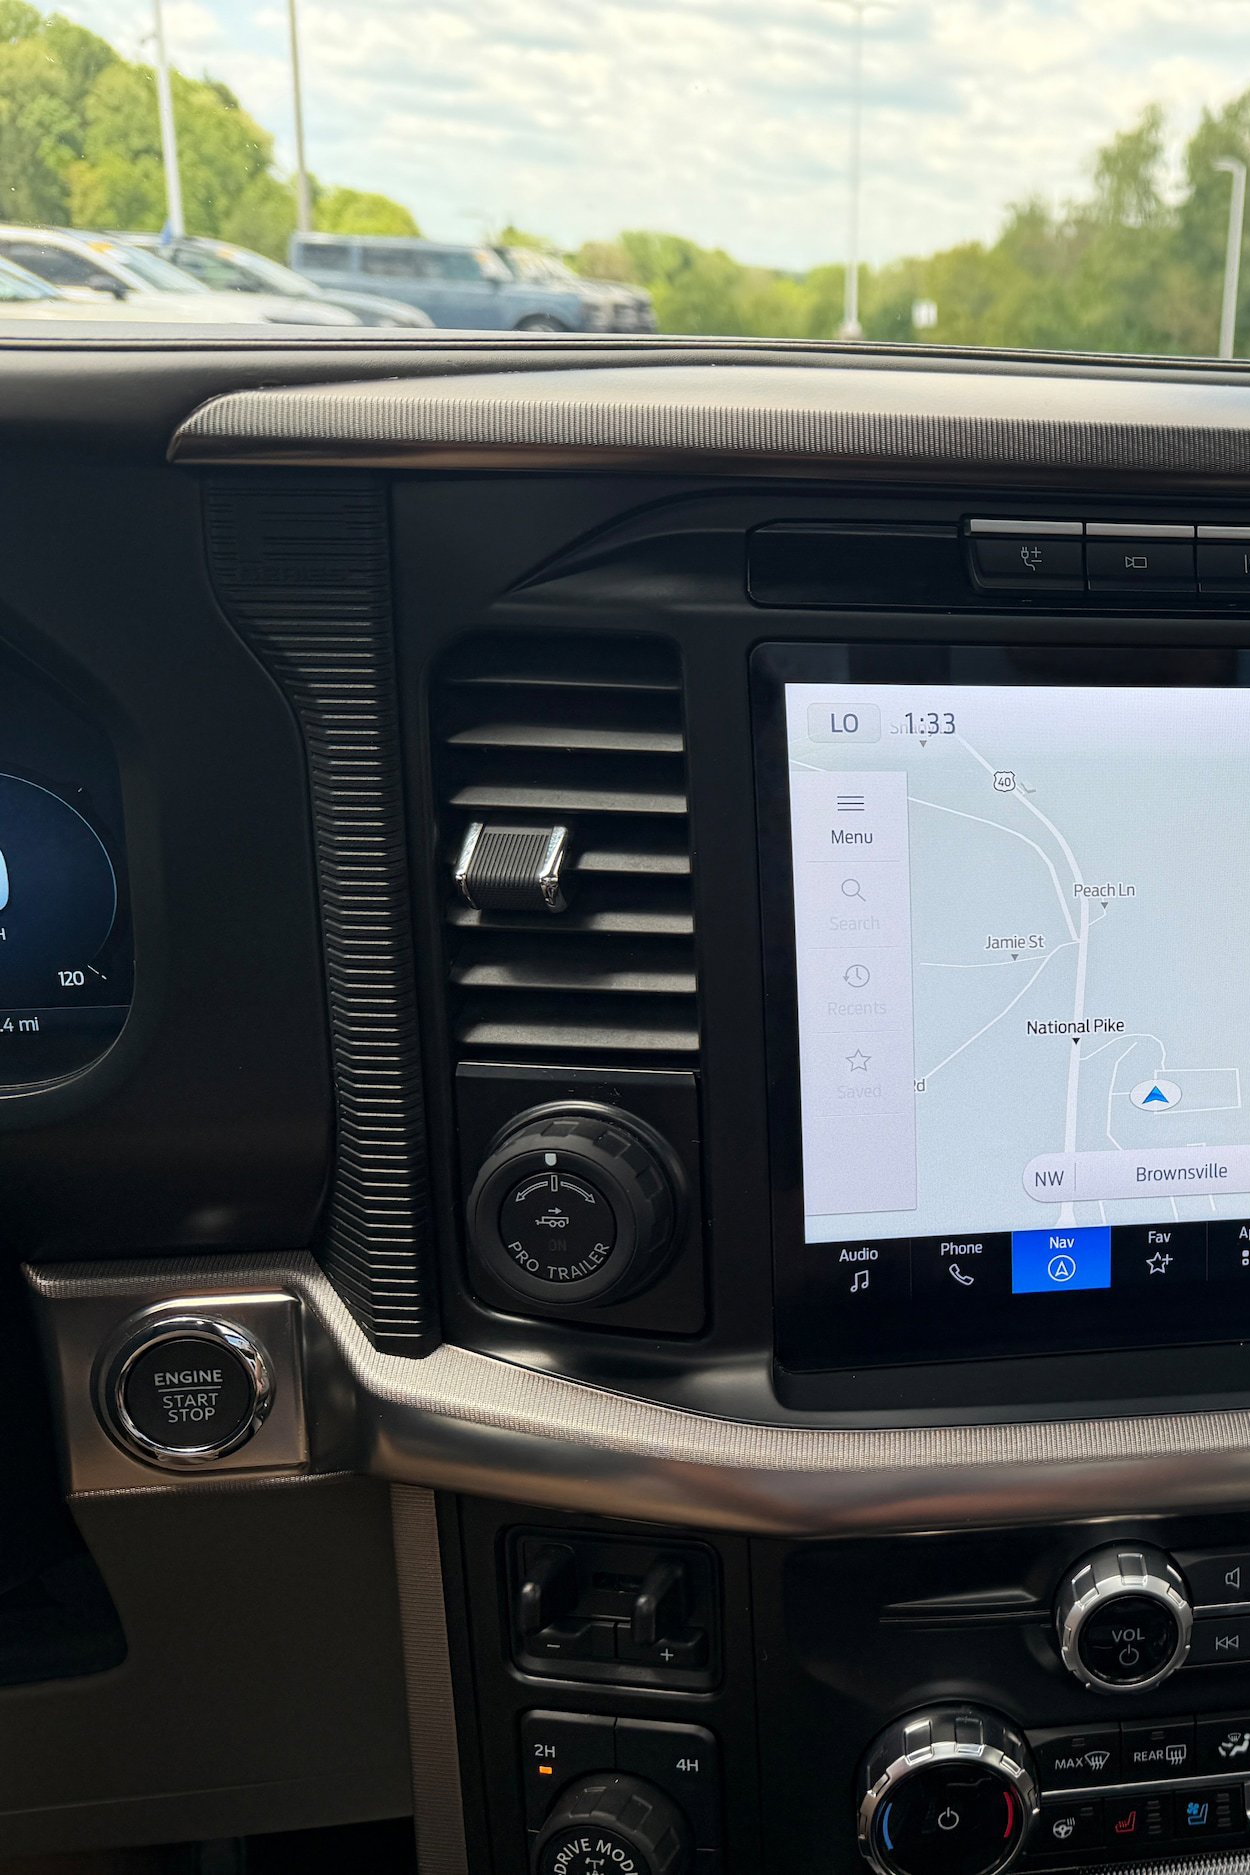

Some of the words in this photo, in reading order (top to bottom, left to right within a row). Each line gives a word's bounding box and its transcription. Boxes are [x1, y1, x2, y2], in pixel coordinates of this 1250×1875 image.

[830, 713, 859, 734] LO
[904, 712, 956, 735] 1:33
[997, 777, 1012, 788] 40
[831, 829, 874, 845] Menu
[1073, 882, 1116, 898] Peach
[1119, 882, 1136, 897] Ln
[829, 915, 881, 931] Search
[985, 934, 1026, 951] Jamie
[1029, 934, 1045, 948] St
[58, 970, 85, 987] 120
[827, 1001, 887, 1016] Recents
[18, 1016, 40, 1032] mi
[1026, 1018, 1091, 1035] National
[1094, 1018, 1125, 1033] Pike
[837, 1083, 882, 1099] Saved
[914, 1079, 925, 1091] d
[1034, 1171, 1065, 1188] NW
[1136, 1163, 1228, 1183] Brownsville
[1049, 1235, 1075, 1250] Nav
[1148, 1230, 1171, 1245] Fav
[839, 1247, 878, 1263] Audio
[940, 1241, 983, 1256] Phone
[508, 1241, 540, 1273] PRO
[547, 1242, 610, 1281] TRAILER
[154, 1369, 224, 1387] ENGINE
[162, 1393, 219, 1409] START
[168, 1407, 216, 1423] STOP
[1111, 1628, 1146, 1643] VOL
[534, 1743, 556, 1759] 2H
[1133, 1749, 1164, 1763] REAR
[675, 1758, 699, 1773] 4H
[1054, 1756, 1084, 1771] MAX
[554, 1838, 592, 1875] DRIVE
[596, 1840, 639, 1875] MOD
